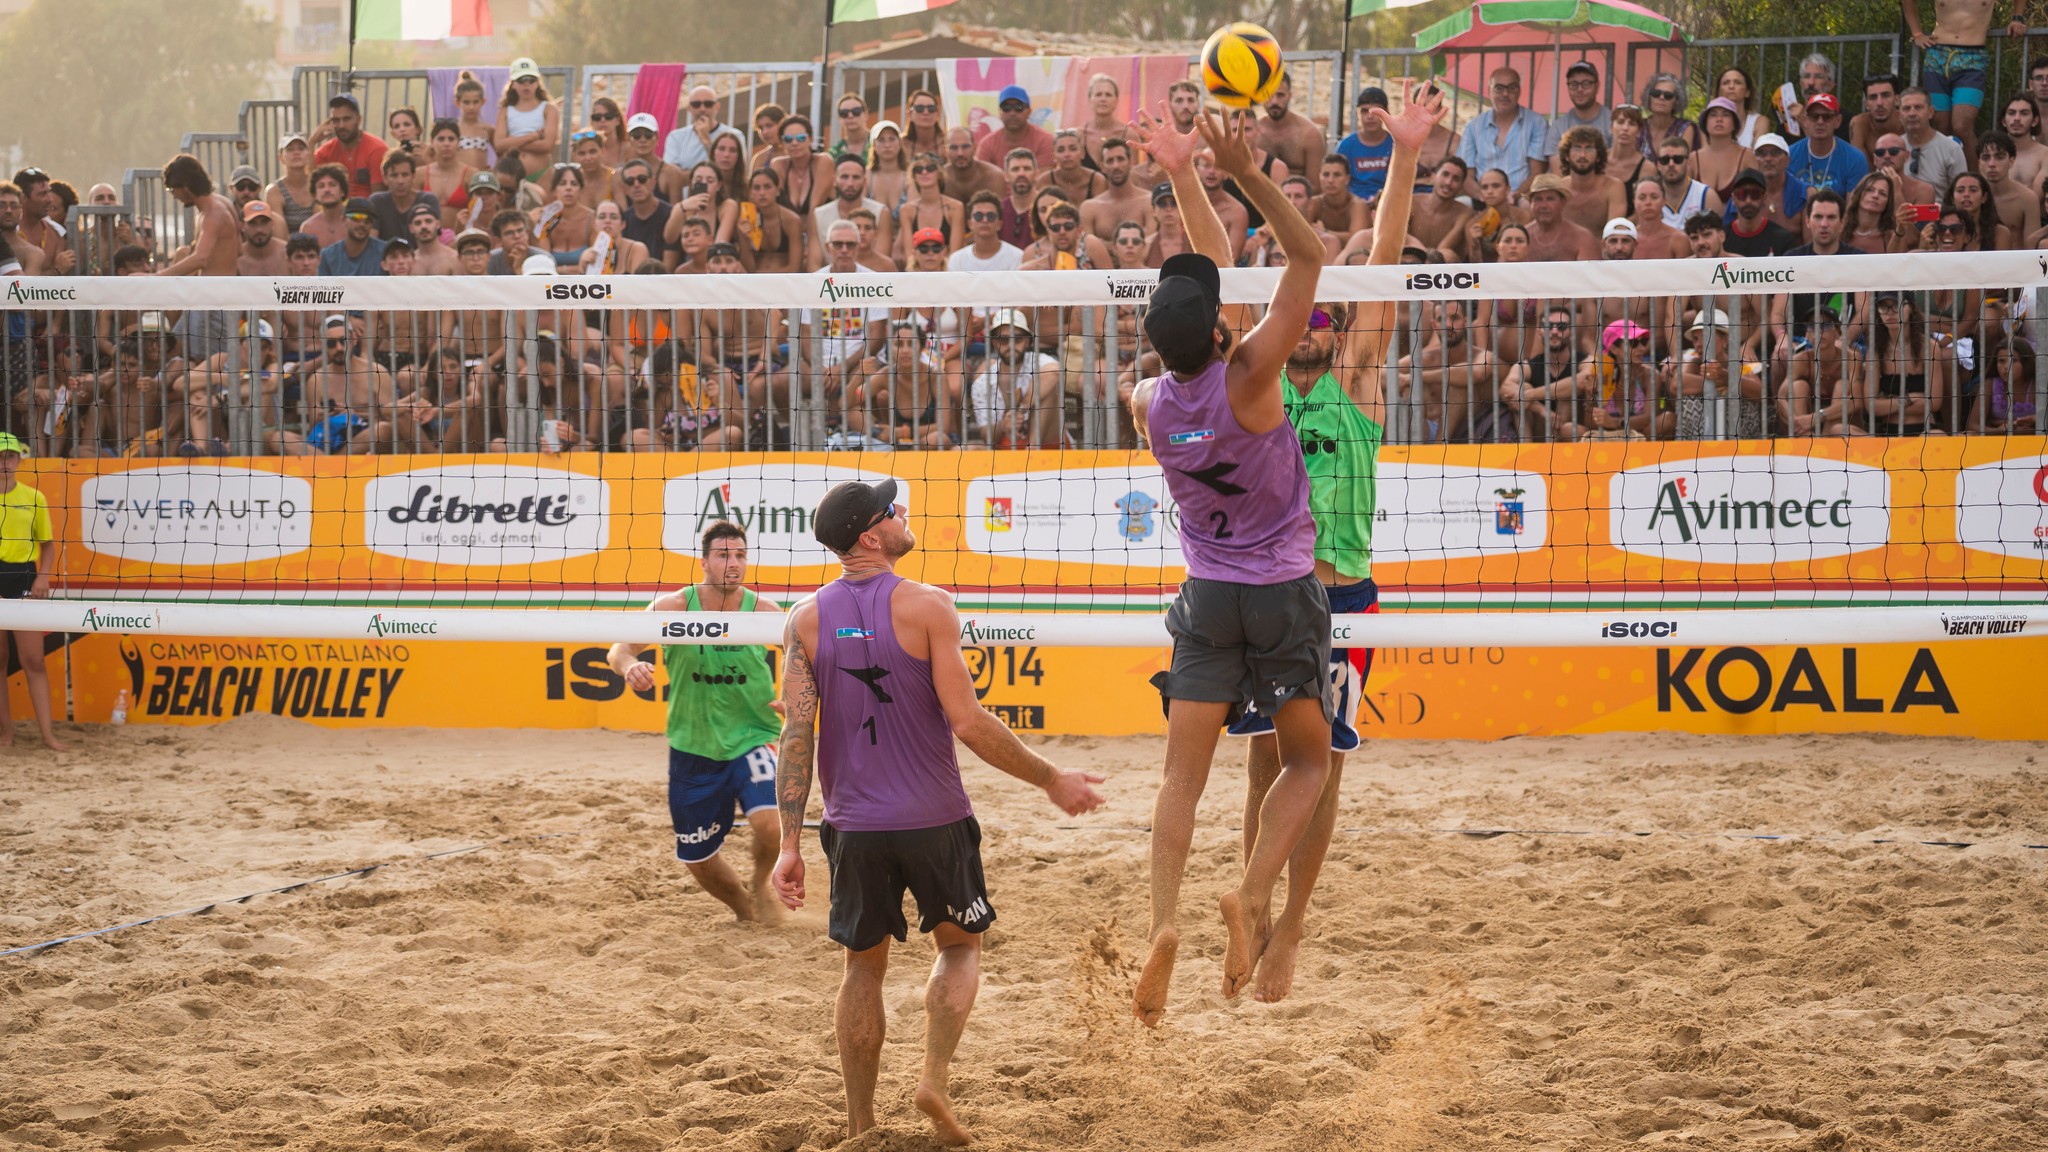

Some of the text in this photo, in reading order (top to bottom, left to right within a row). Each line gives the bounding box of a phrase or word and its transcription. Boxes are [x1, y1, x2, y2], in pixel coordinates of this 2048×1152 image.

[1711, 262, 1795, 289] Avimecc
[7, 280, 77, 304] Avimecc
[281, 290, 345, 304] BEACH VOLLEY
[819, 277, 894, 303] Avimecc
[1115, 285, 1147, 298] BEACH
[133, 500, 296, 519] VERAUTO
[388, 485, 577, 527] Libretti
[1647, 477, 1852, 543] Avimecc
[490, 532, 541, 543] domani
[1209, 510, 1234, 540] 2
[82, 607, 152, 631] Avimecc
[367, 613, 438, 638] Avimecc
[1949, 620, 2027, 635] BEACH VOLLEY
[960, 620, 1036, 645] Avimecc
[150, 643, 410, 663] CAMPIONATO ITALIANO
[1003, 646, 1045, 687] 14
[146, 666, 405, 718] BEACH VOLLEY
[1656, 646, 1960, 715] KOALA
[862, 715, 878, 746] 1
